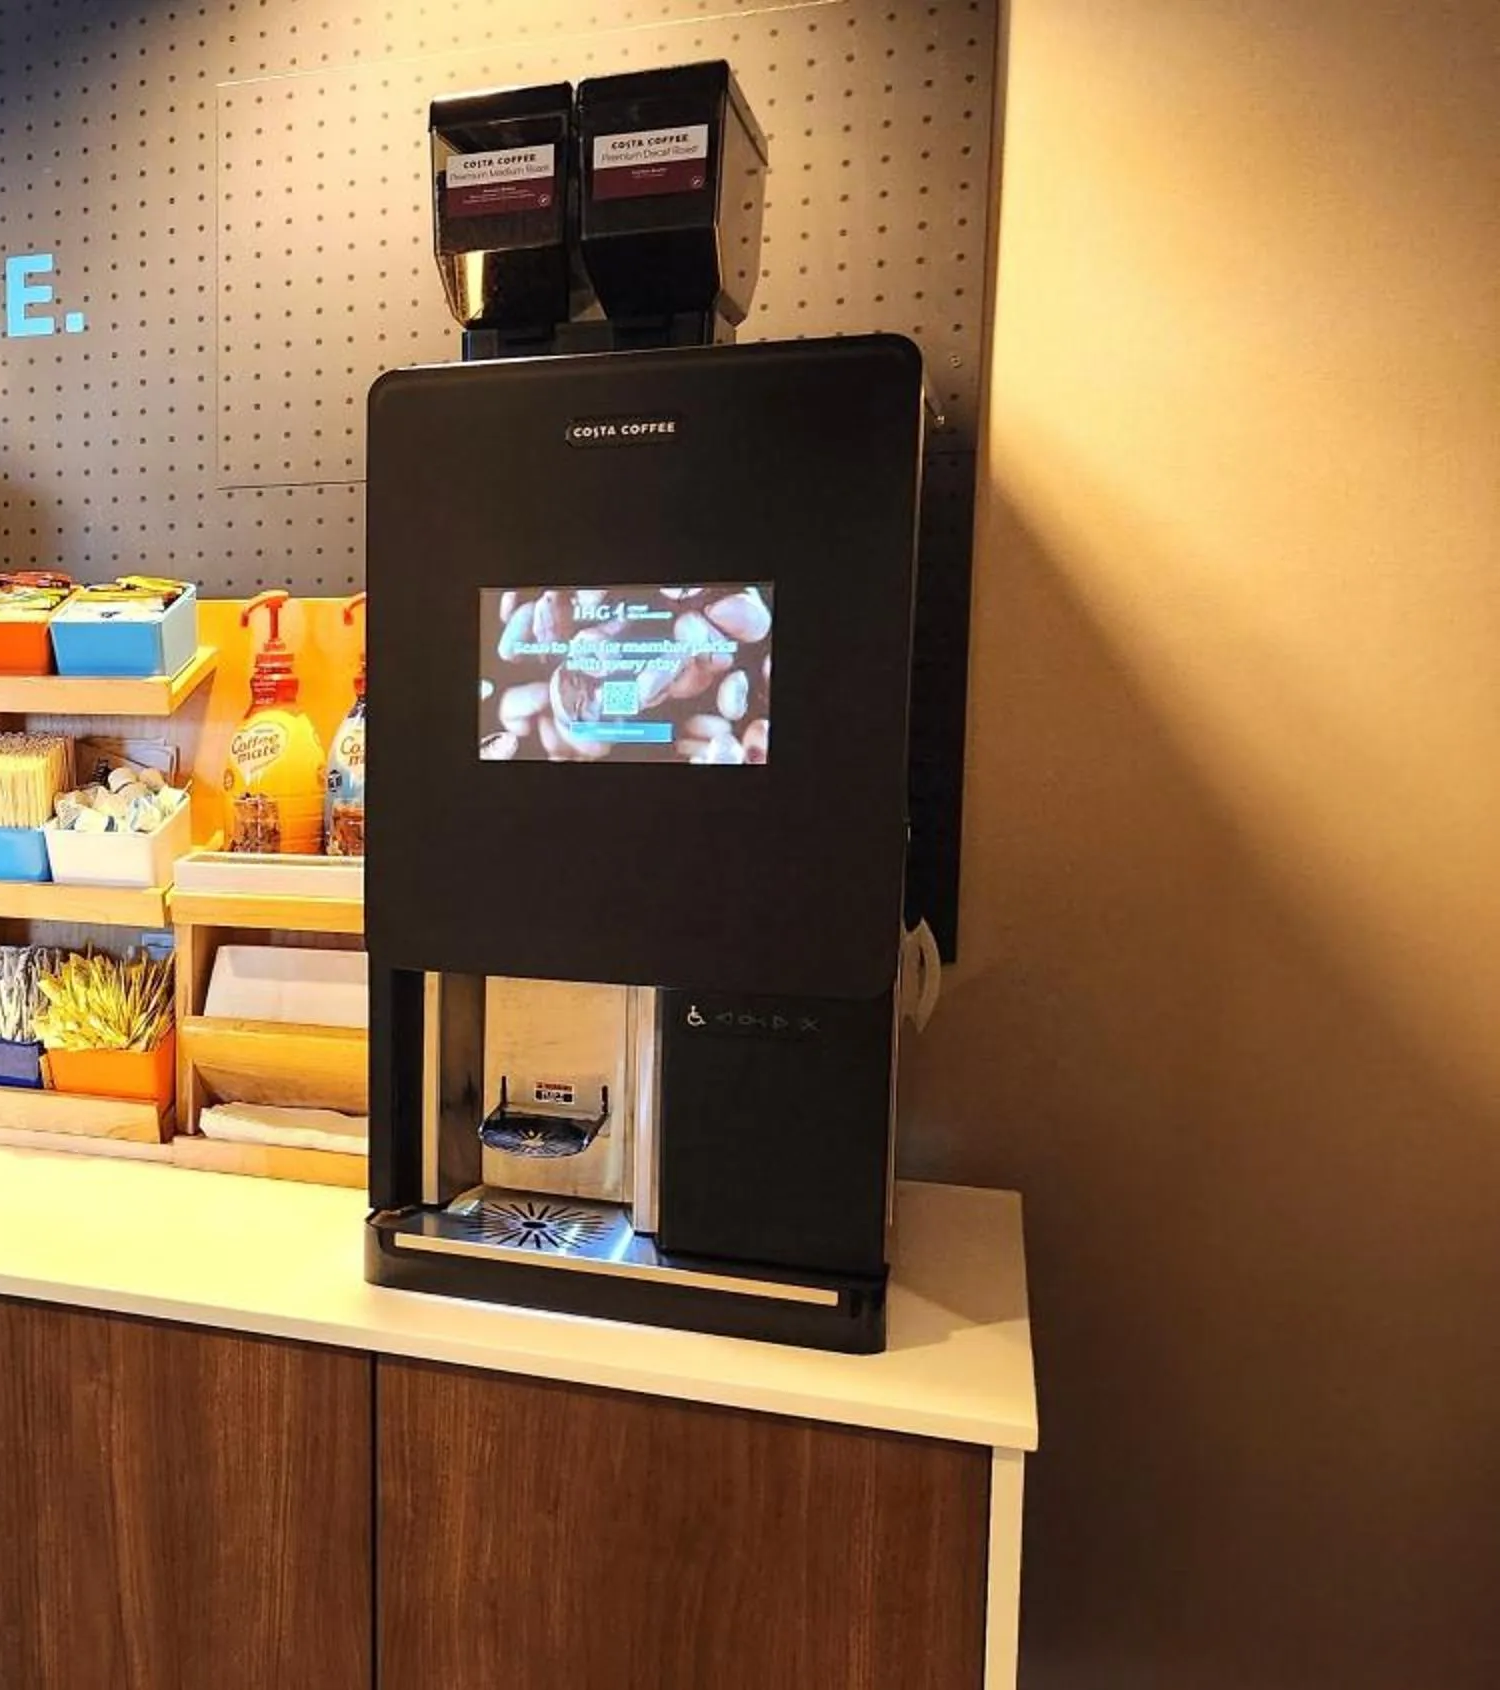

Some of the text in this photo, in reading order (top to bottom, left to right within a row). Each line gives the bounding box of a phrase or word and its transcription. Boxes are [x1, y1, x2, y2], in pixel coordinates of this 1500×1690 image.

[612, 134, 689, 150] COSTA COFFEE
[463, 153, 536, 169] COSTA COFFEE
[573, 421, 676, 438] COSTA COFFEE
[573, 604, 611, 621] IHG
[232, 734, 280, 755] Coffee
[237, 743, 281, 764] mate
